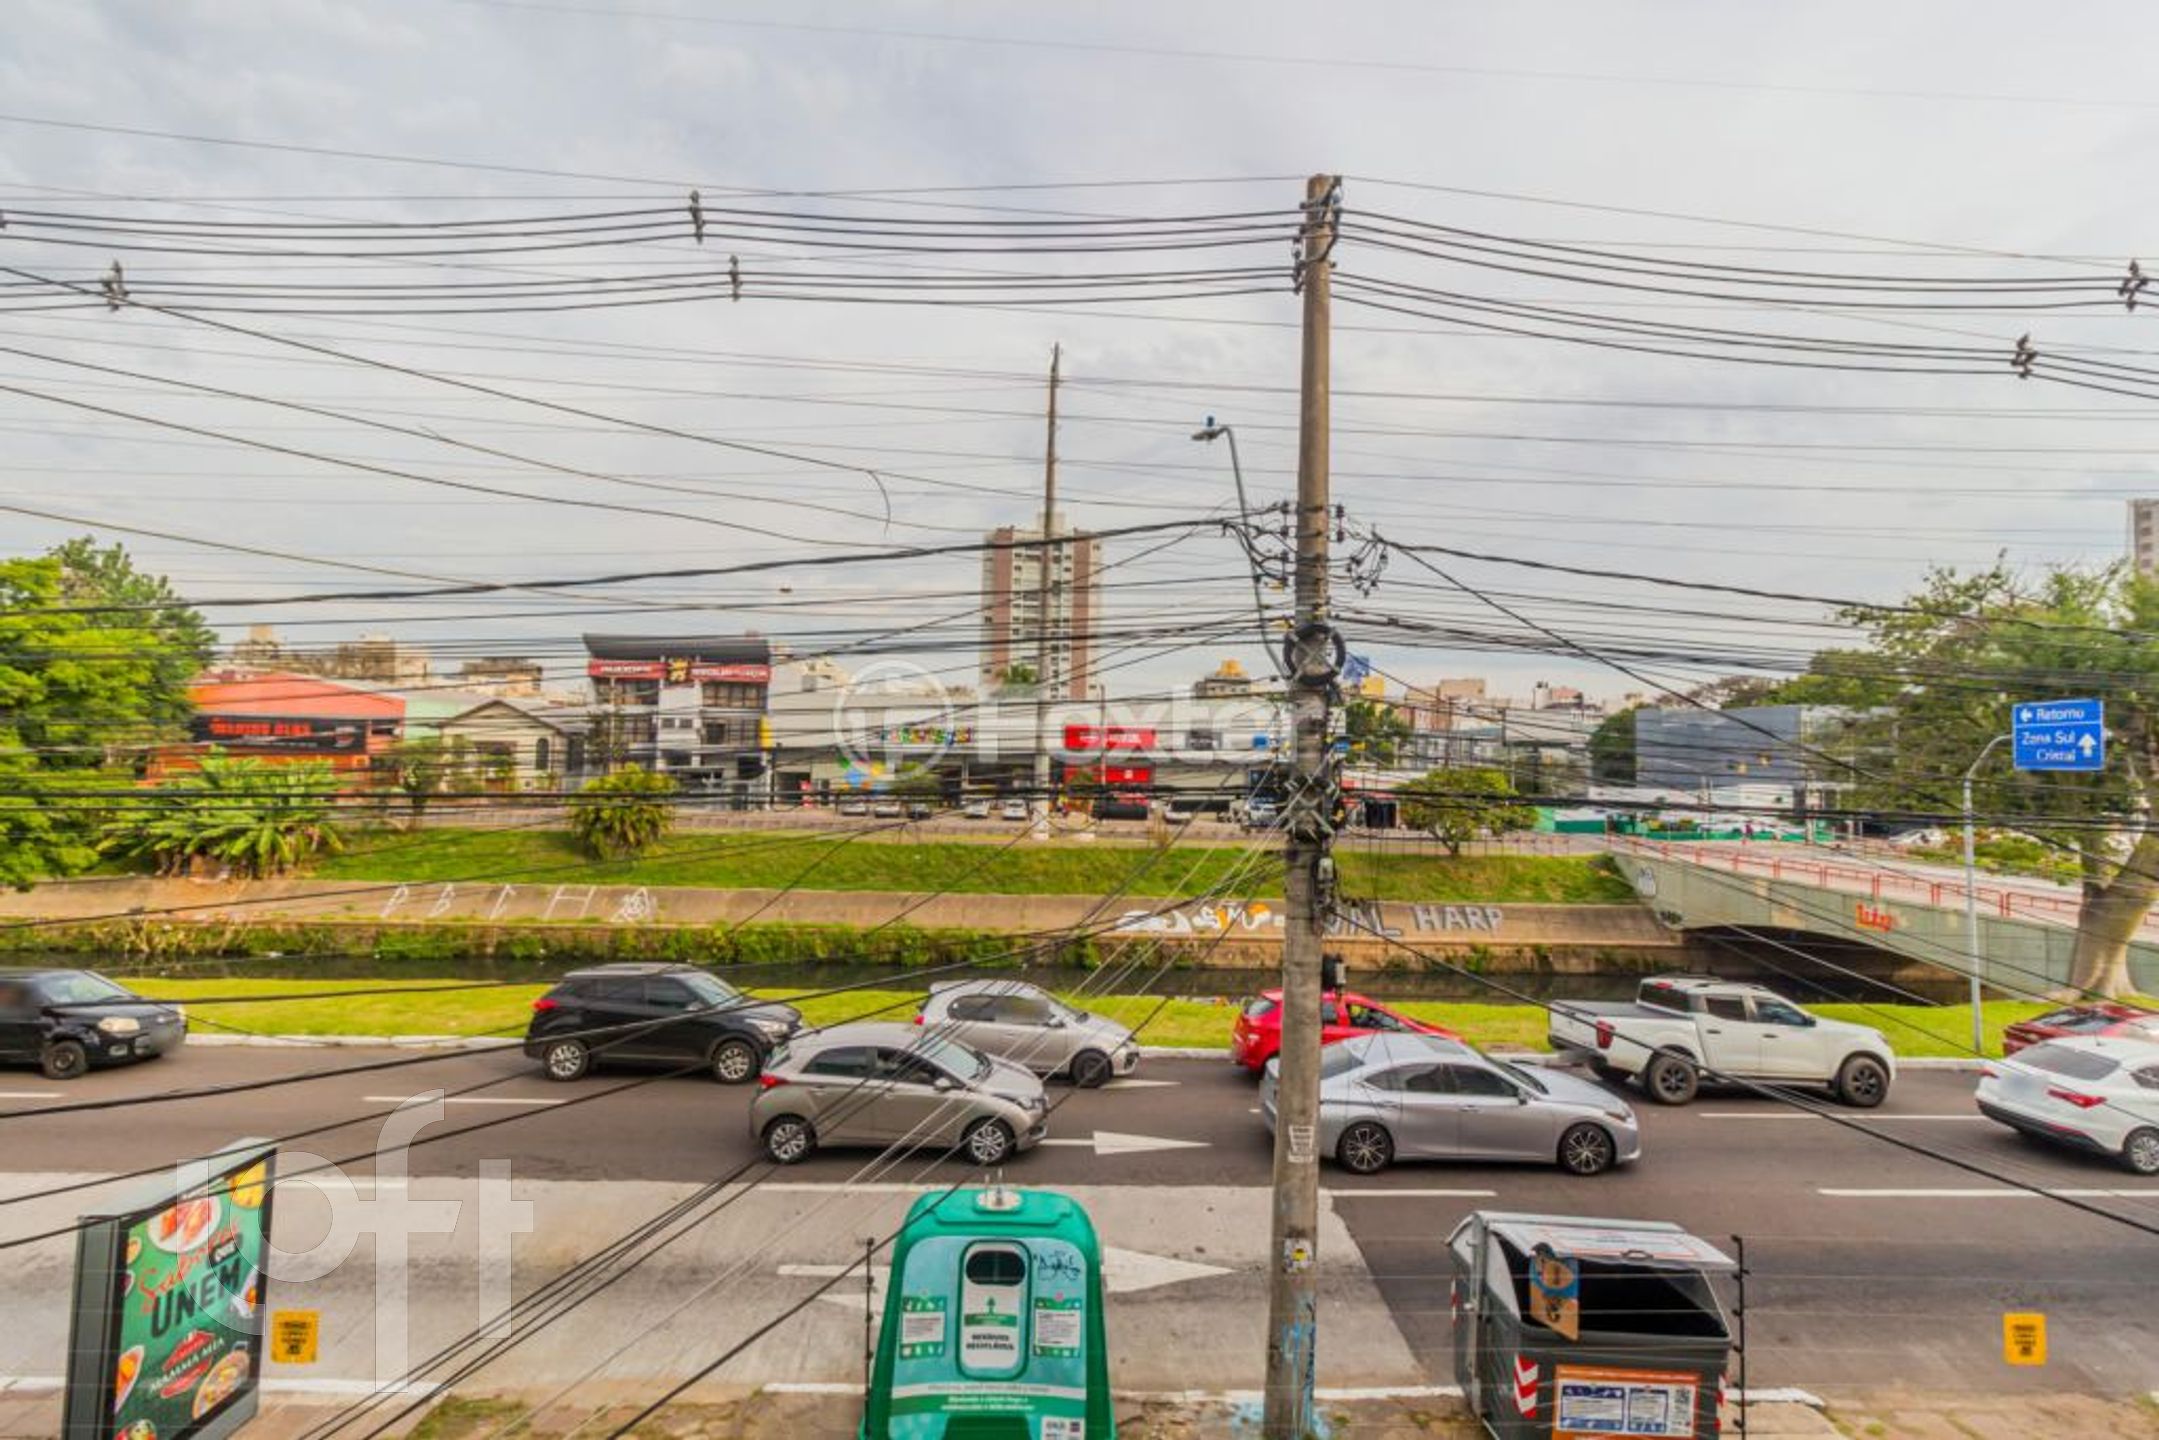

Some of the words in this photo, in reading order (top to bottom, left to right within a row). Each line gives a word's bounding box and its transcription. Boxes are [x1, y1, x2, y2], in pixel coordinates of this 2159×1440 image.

[2037, 708, 2085, 721] Retorno
[2021, 732, 2051, 746] Zona
[2055, 729, 2076, 745] Sul
[2037, 748, 2076, 763] Cristal
[1410, 906, 1504, 936] HARP
[151, 1257, 241, 1338] UNEM
